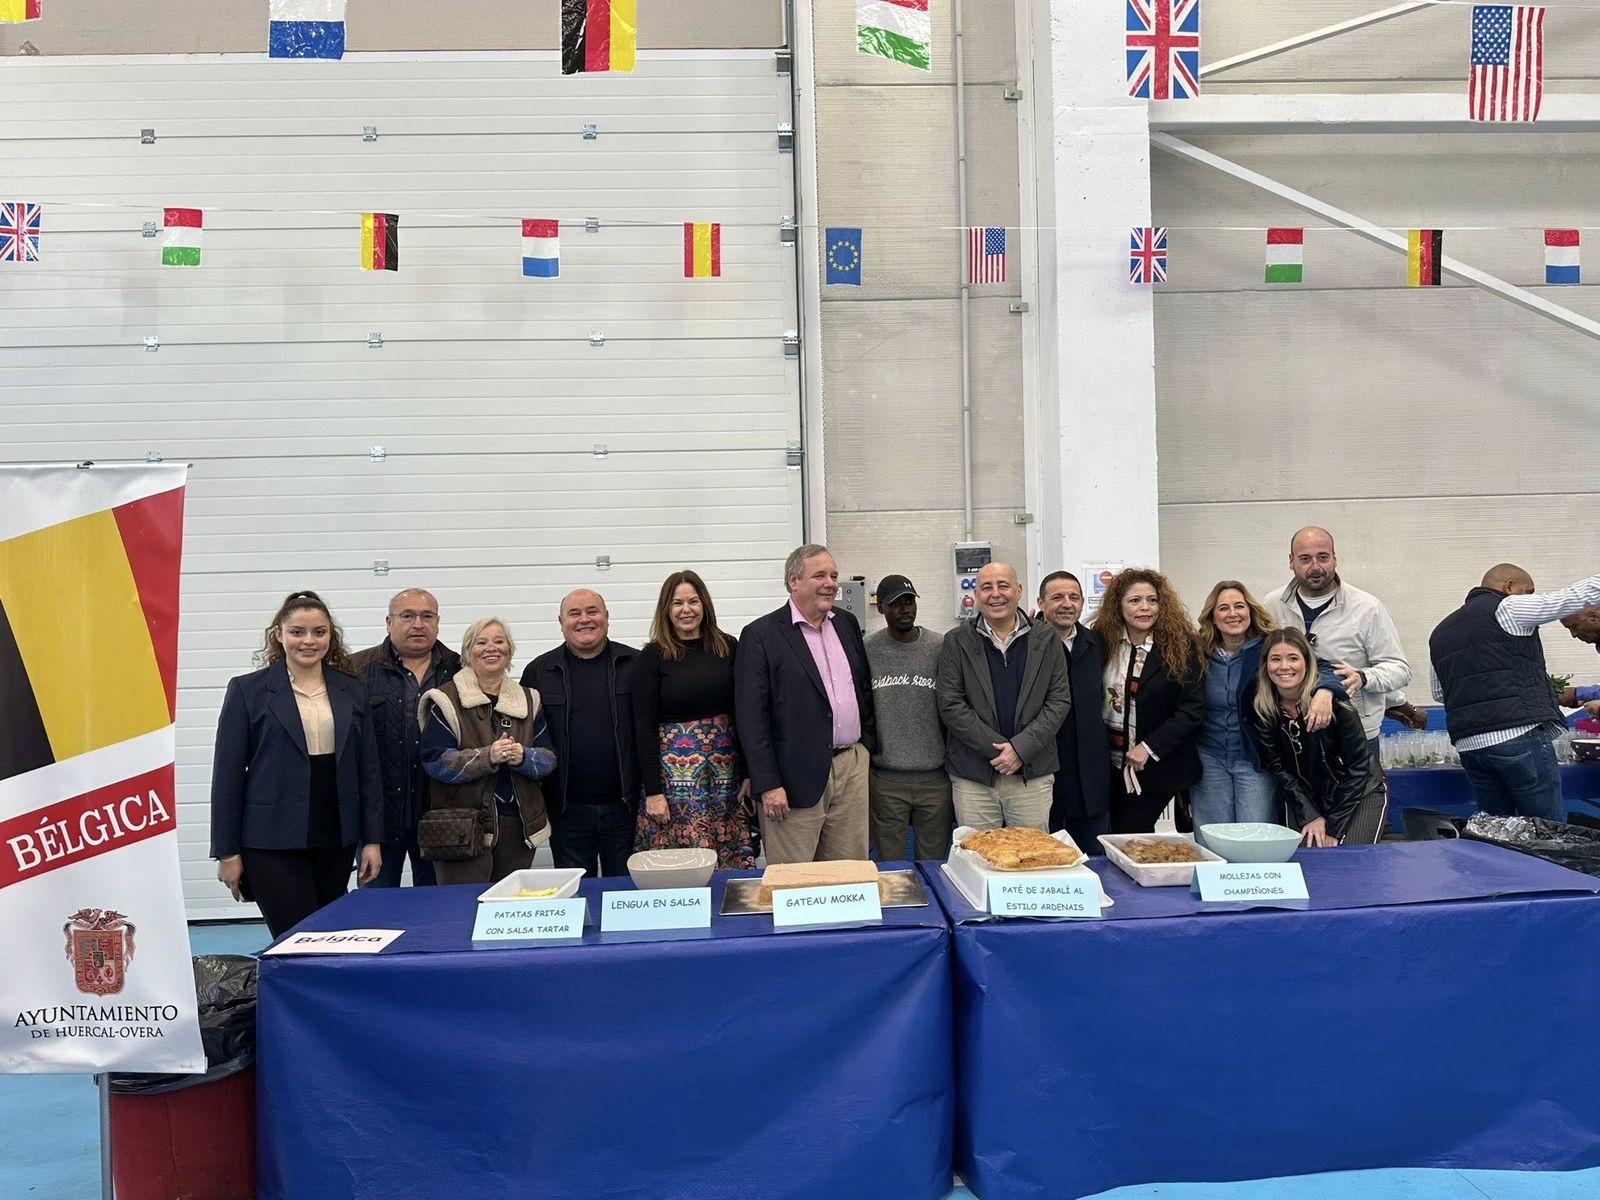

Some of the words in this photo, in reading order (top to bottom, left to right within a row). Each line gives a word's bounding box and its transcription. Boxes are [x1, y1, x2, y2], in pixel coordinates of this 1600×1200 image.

[872, 673, 910, 690] aidback
[6, 789, 170, 872] BÉLGICA
[1219, 872, 1261, 880] MOLLEJAS
[1002, 884, 1023, 894] PATÉ
[1026, 886, 1037, 894] DE
[1039, 885, 1070, 895] JABALÍ
[1223, 886, 1284, 896] CHAMPIÑONES
[611, 900, 650, 910] LENGUA
[652, 898, 667, 907] EN
[669, 898, 701, 907] SALSA
[786, 896, 827, 907] GATEAU
[830, 893, 865, 904] MOKKA
[1006, 902, 1037, 910] ESTILO
[1040, 903, 1084, 911] ARDENAIS
[494, 910, 533, 919] PATATAS
[534, 909, 566, 918] FRITAS
[485, 926, 504, 935] CON
[506, 926, 534, 934] SALSA
[537, 925, 570, 933] TARTAR
[294, 935, 382, 944] Bélgica
[14, 1005, 178, 1027] AYUNTAMIENTO
[31, 1029, 51, 1039] DE
[55, 1026, 165, 1038] HUERCAL-OVERA
